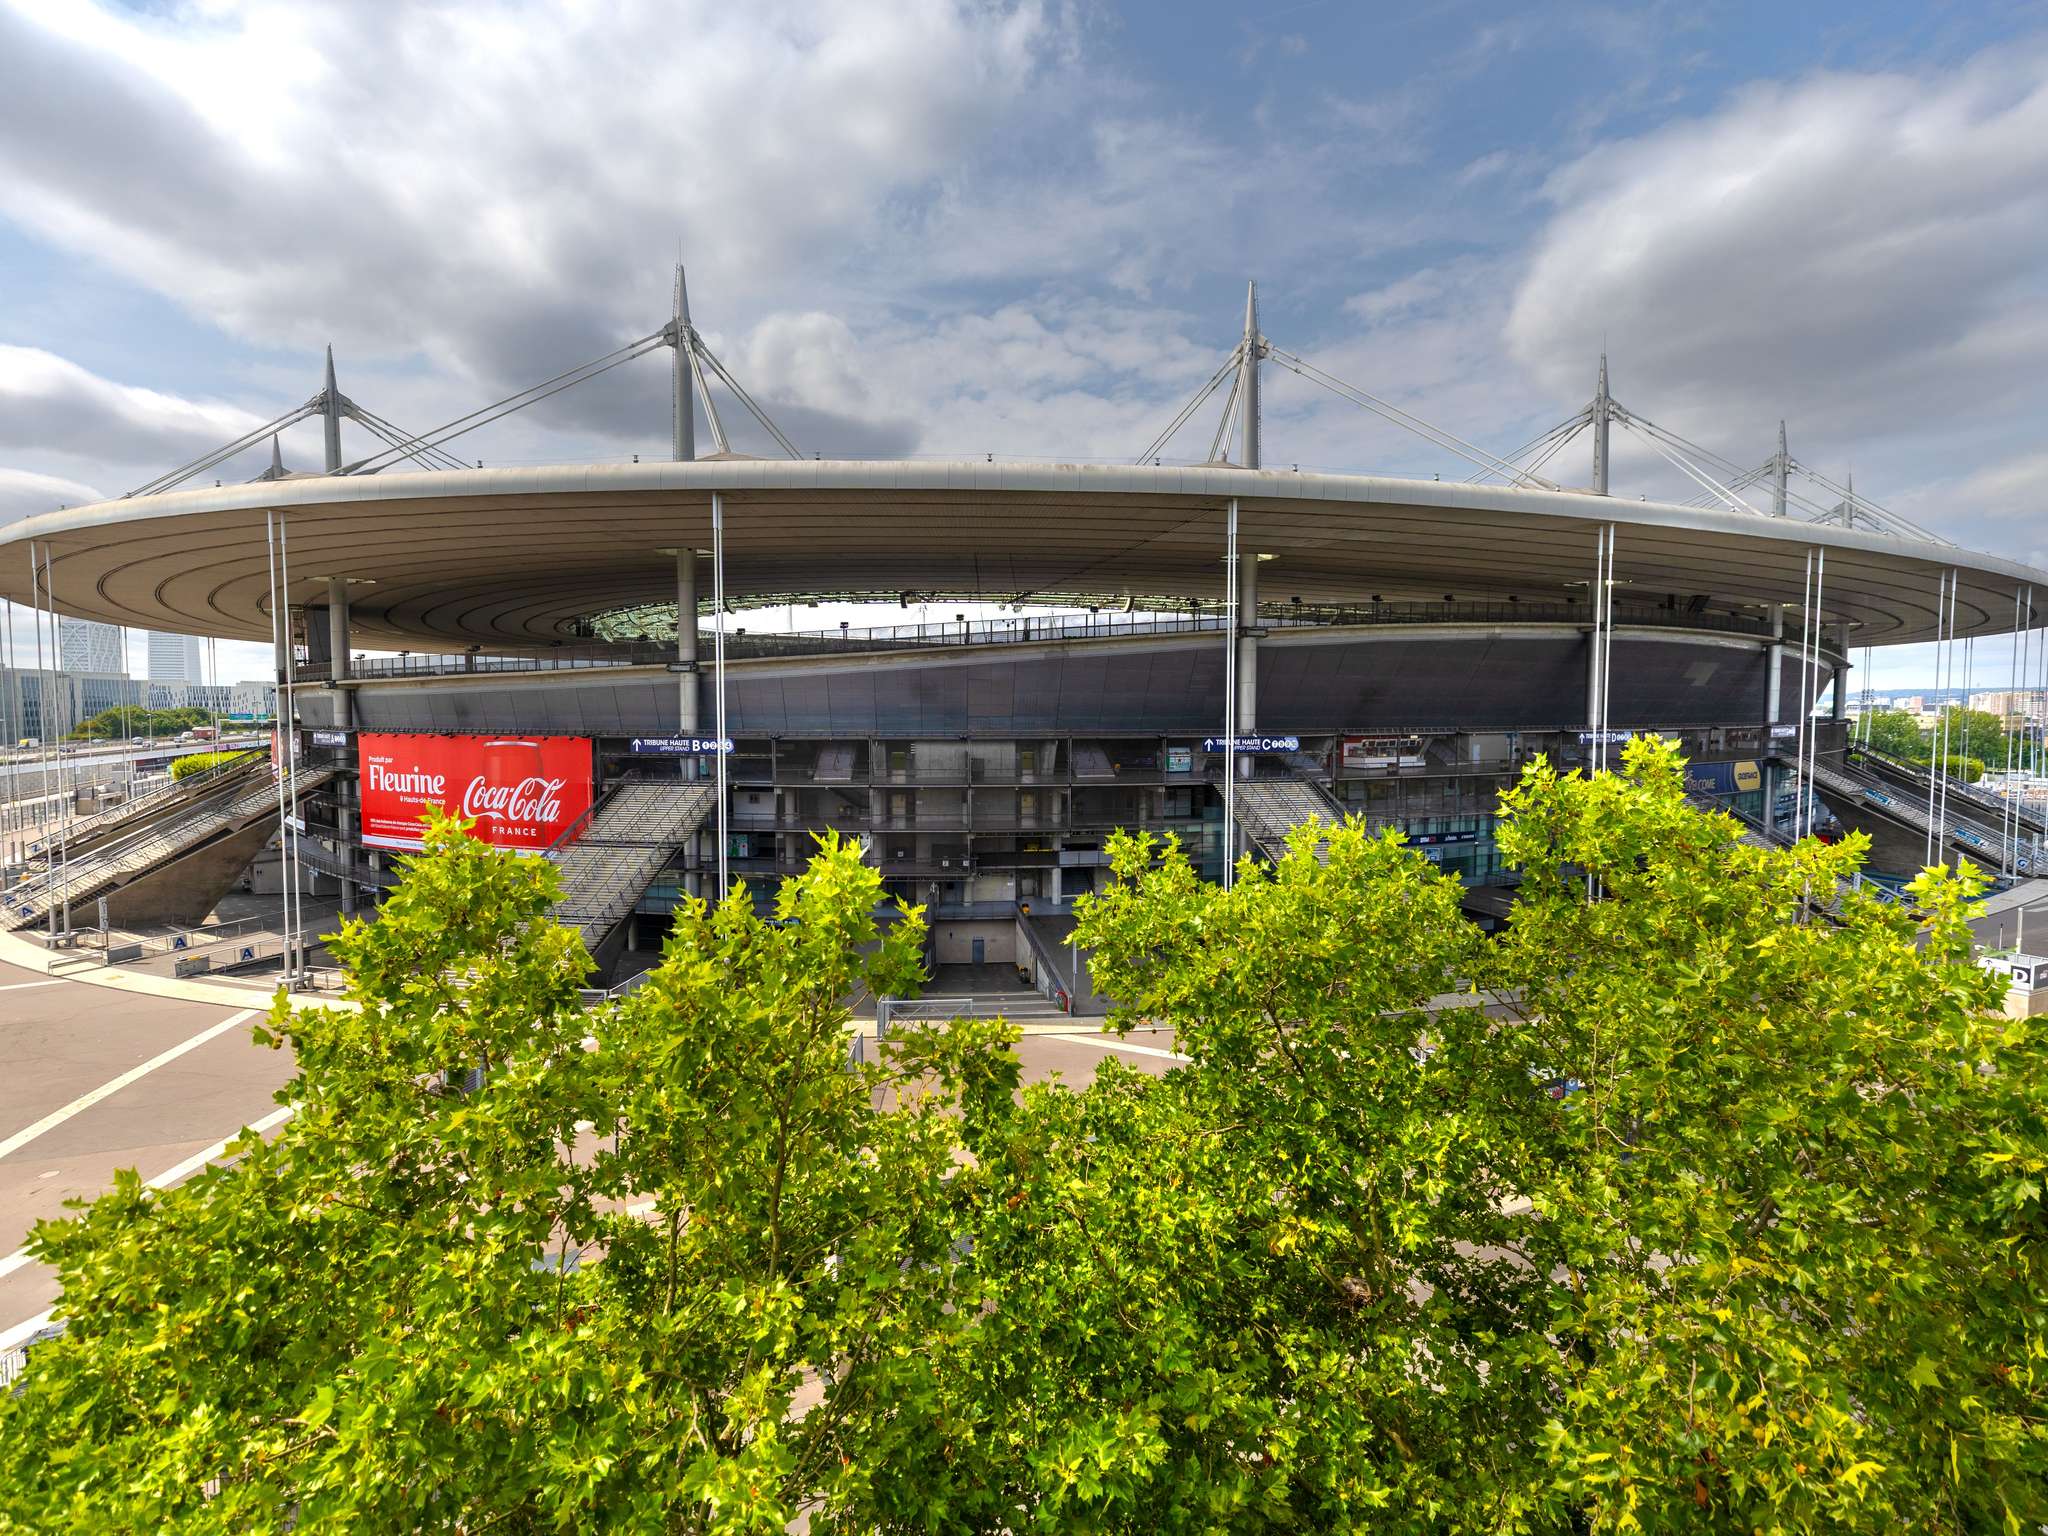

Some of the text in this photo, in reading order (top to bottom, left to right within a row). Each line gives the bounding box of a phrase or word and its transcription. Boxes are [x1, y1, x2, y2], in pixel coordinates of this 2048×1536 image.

[692, 740, 700, 751] B
[1262, 739, 1271, 750] C
[368, 755, 384, 763] Produit
[369, 764, 446, 795] Fleurine
[404, 796, 446, 805] Hauts-deFrance
[463, 775, 567, 822] Coca-Cola
[491, 826, 537, 837] FRANCE
[22, 906, 33, 917] A
[174, 937, 187, 948] A
[241, 948, 254, 960] A
[2012, 968, 2028, 982] D
